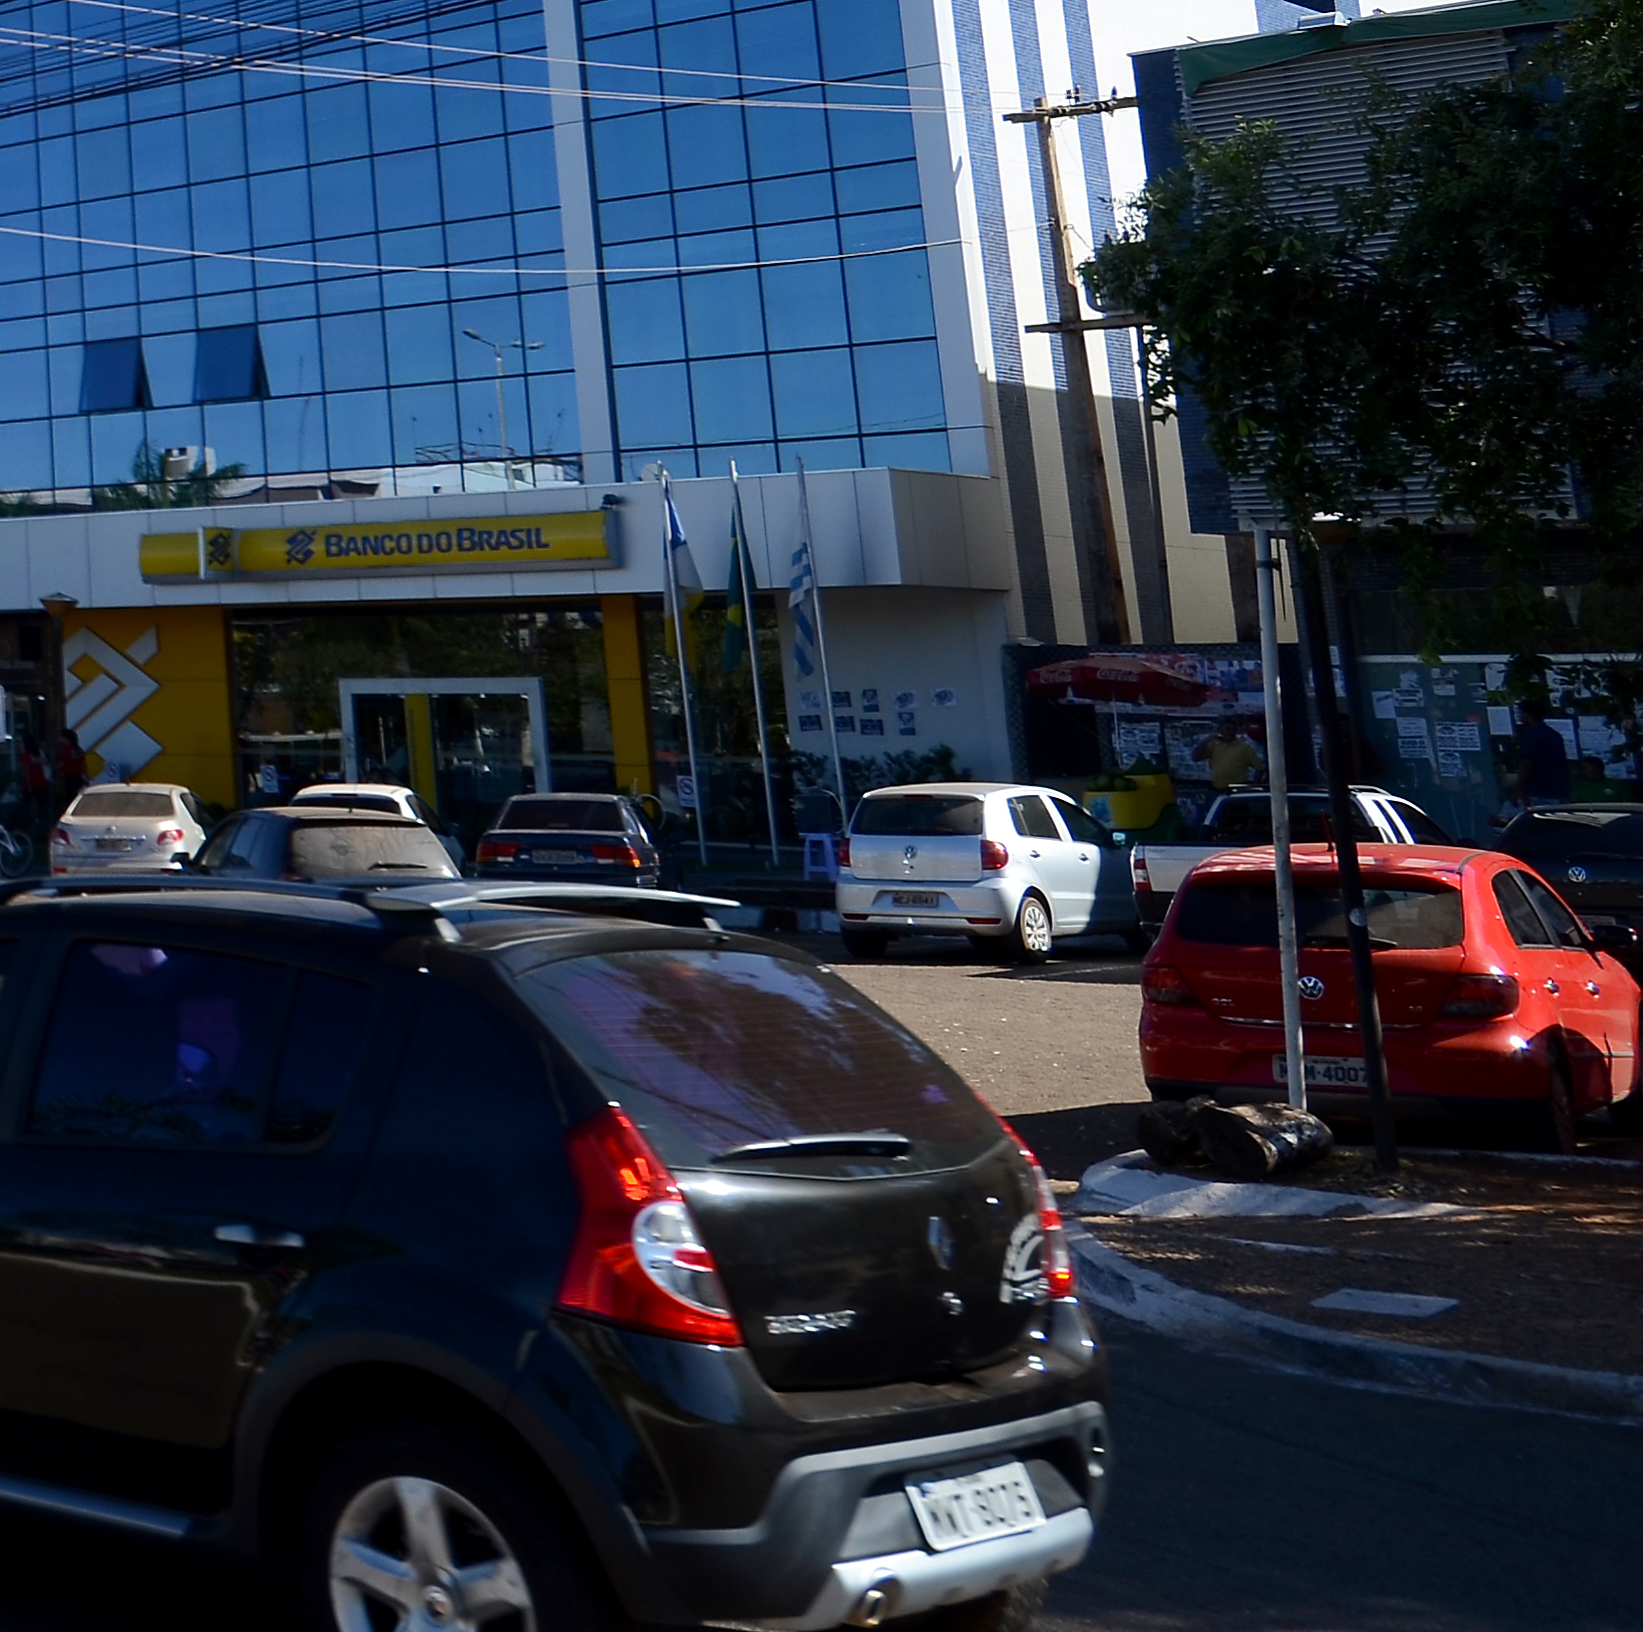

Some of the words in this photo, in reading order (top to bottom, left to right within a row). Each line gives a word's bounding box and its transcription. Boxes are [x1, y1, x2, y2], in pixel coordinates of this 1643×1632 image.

[325, 532, 413, 558] BANCO
[417, 531, 453, 554] DO
[457, 527, 550, 552] BRASIL
